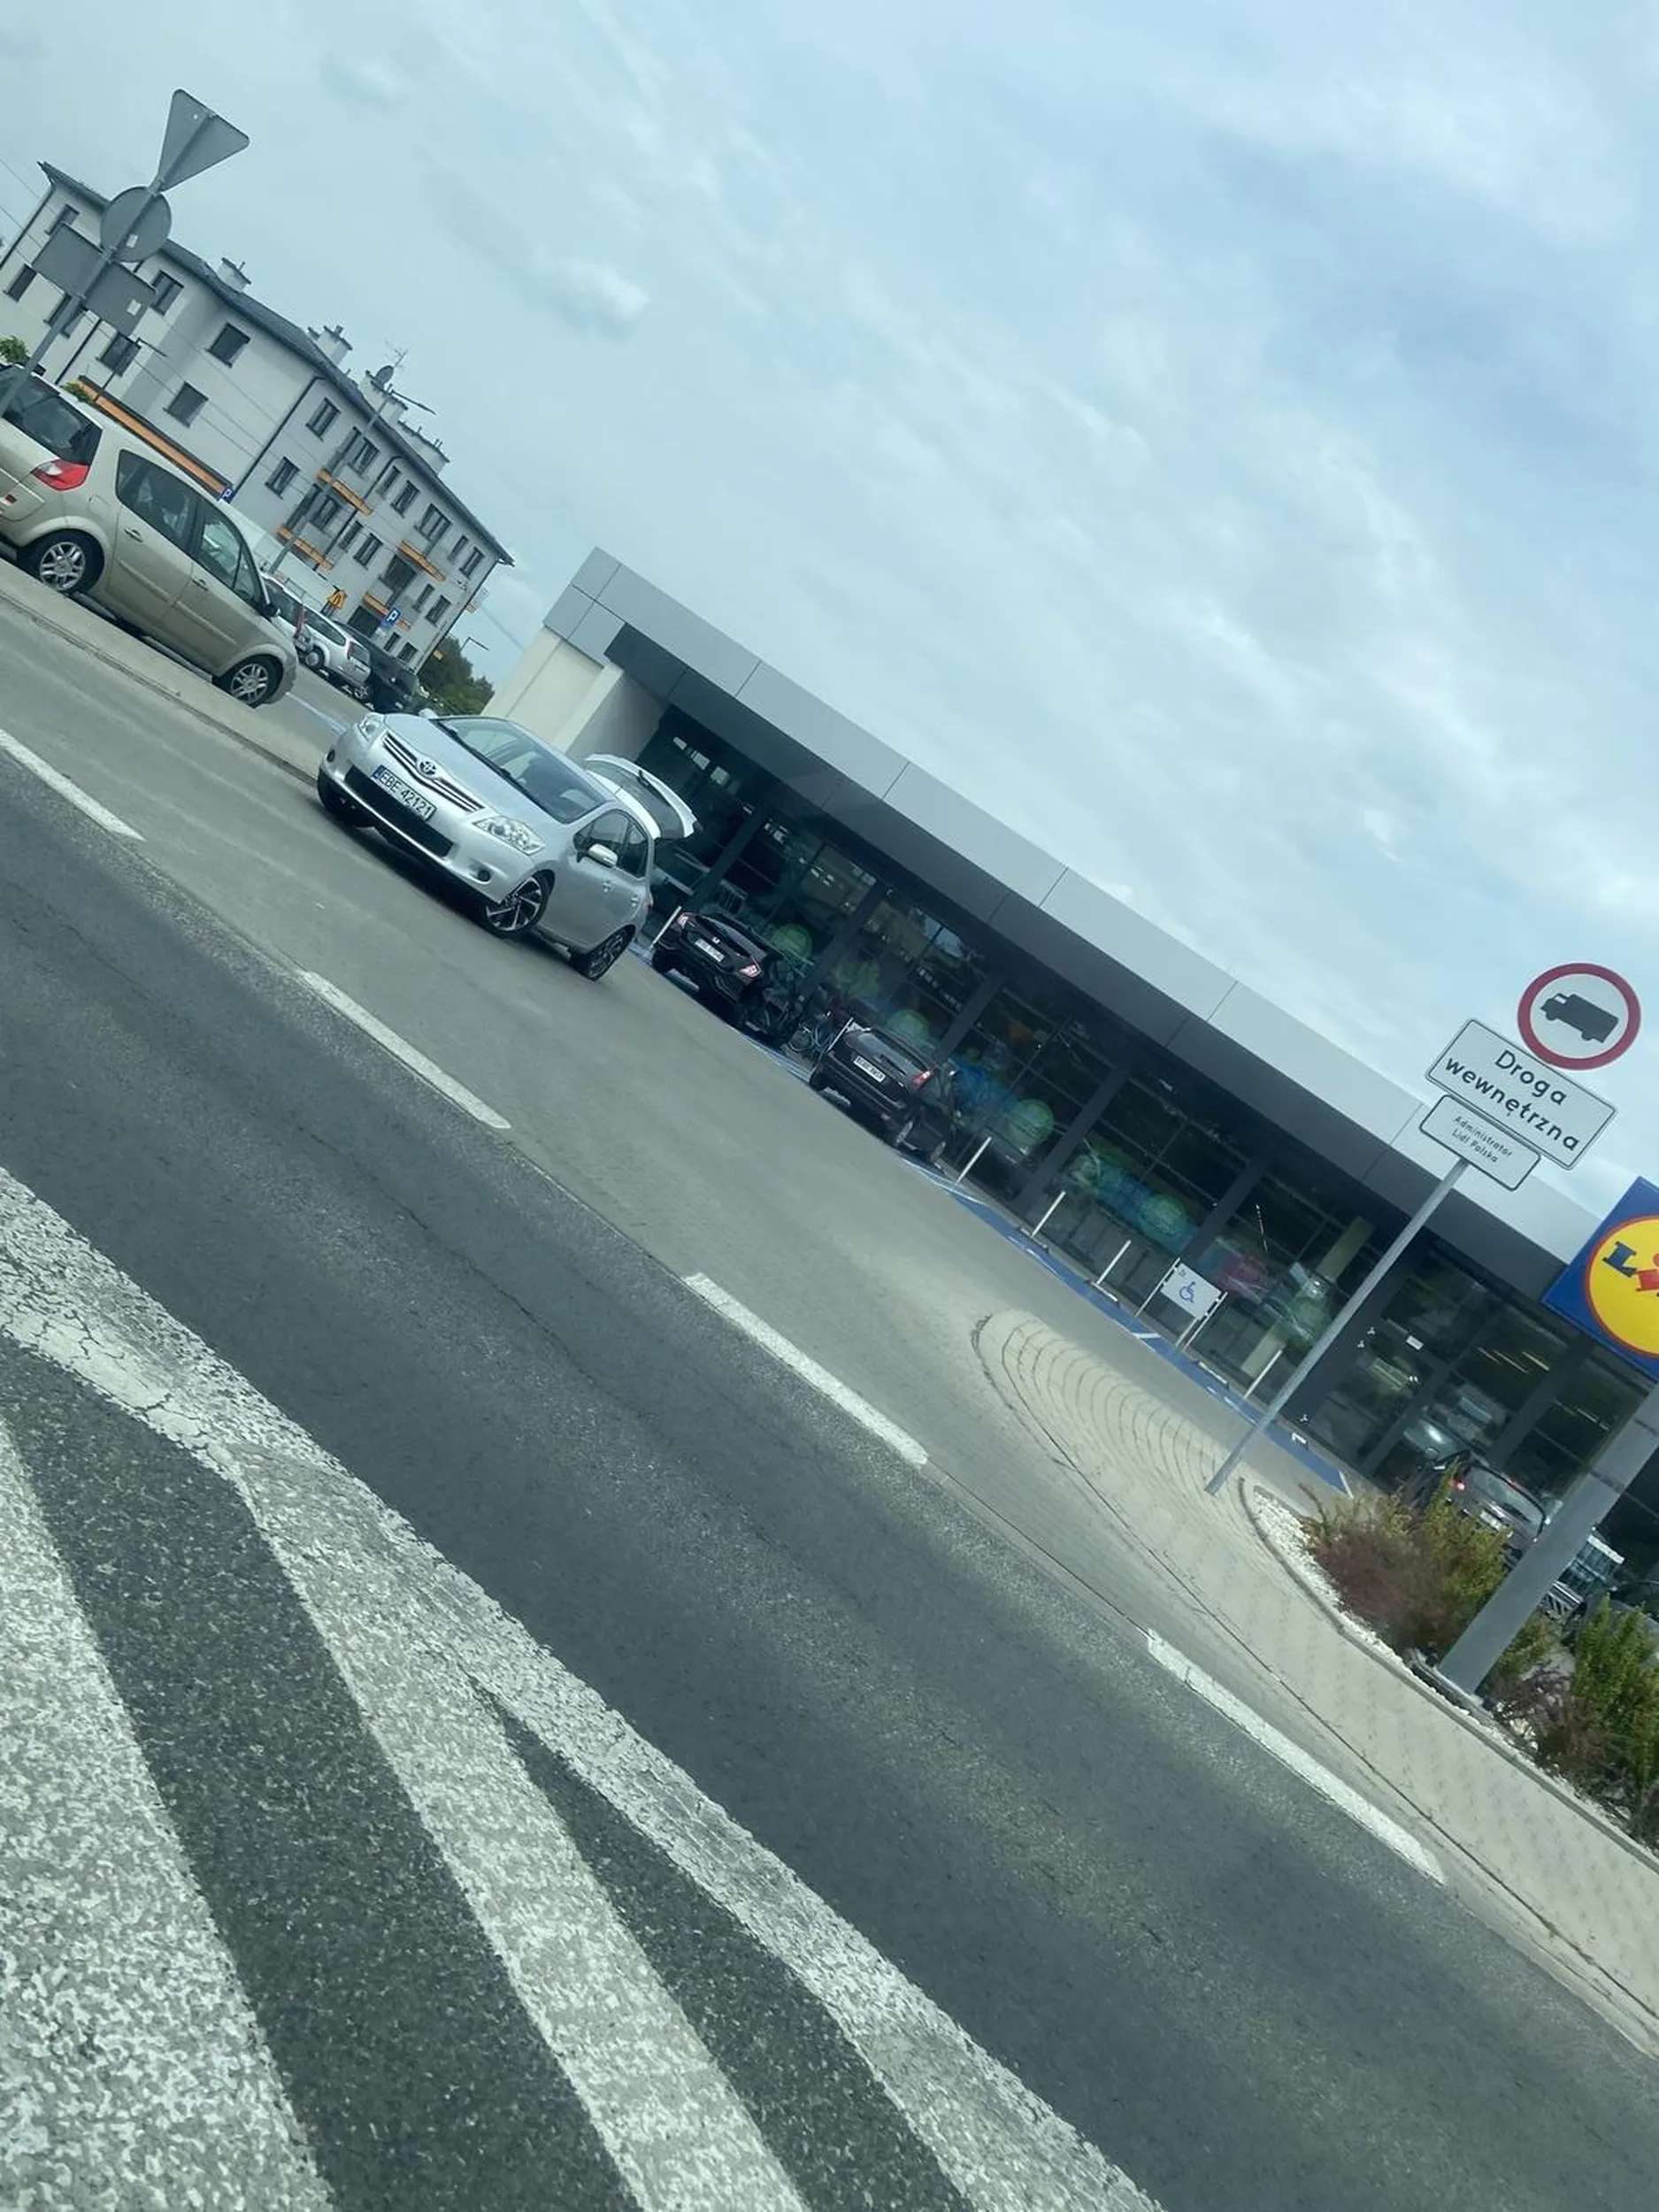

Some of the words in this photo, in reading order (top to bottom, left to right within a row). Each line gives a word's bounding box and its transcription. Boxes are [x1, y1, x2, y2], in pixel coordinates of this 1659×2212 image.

[386, 610, 399, 622] P
[379, 772, 403, 793] EBE
[400, 788, 433, 817] 42121
[1494, 1049, 1567, 1106] Droga
[1445, 1056, 1581, 1153] wewnętrzna
[1452, 1129, 1469, 1145] Lidl
[1471, 1141, 1500, 1163] Polska
[1453, 1116, 1513, 1157] Administrator
